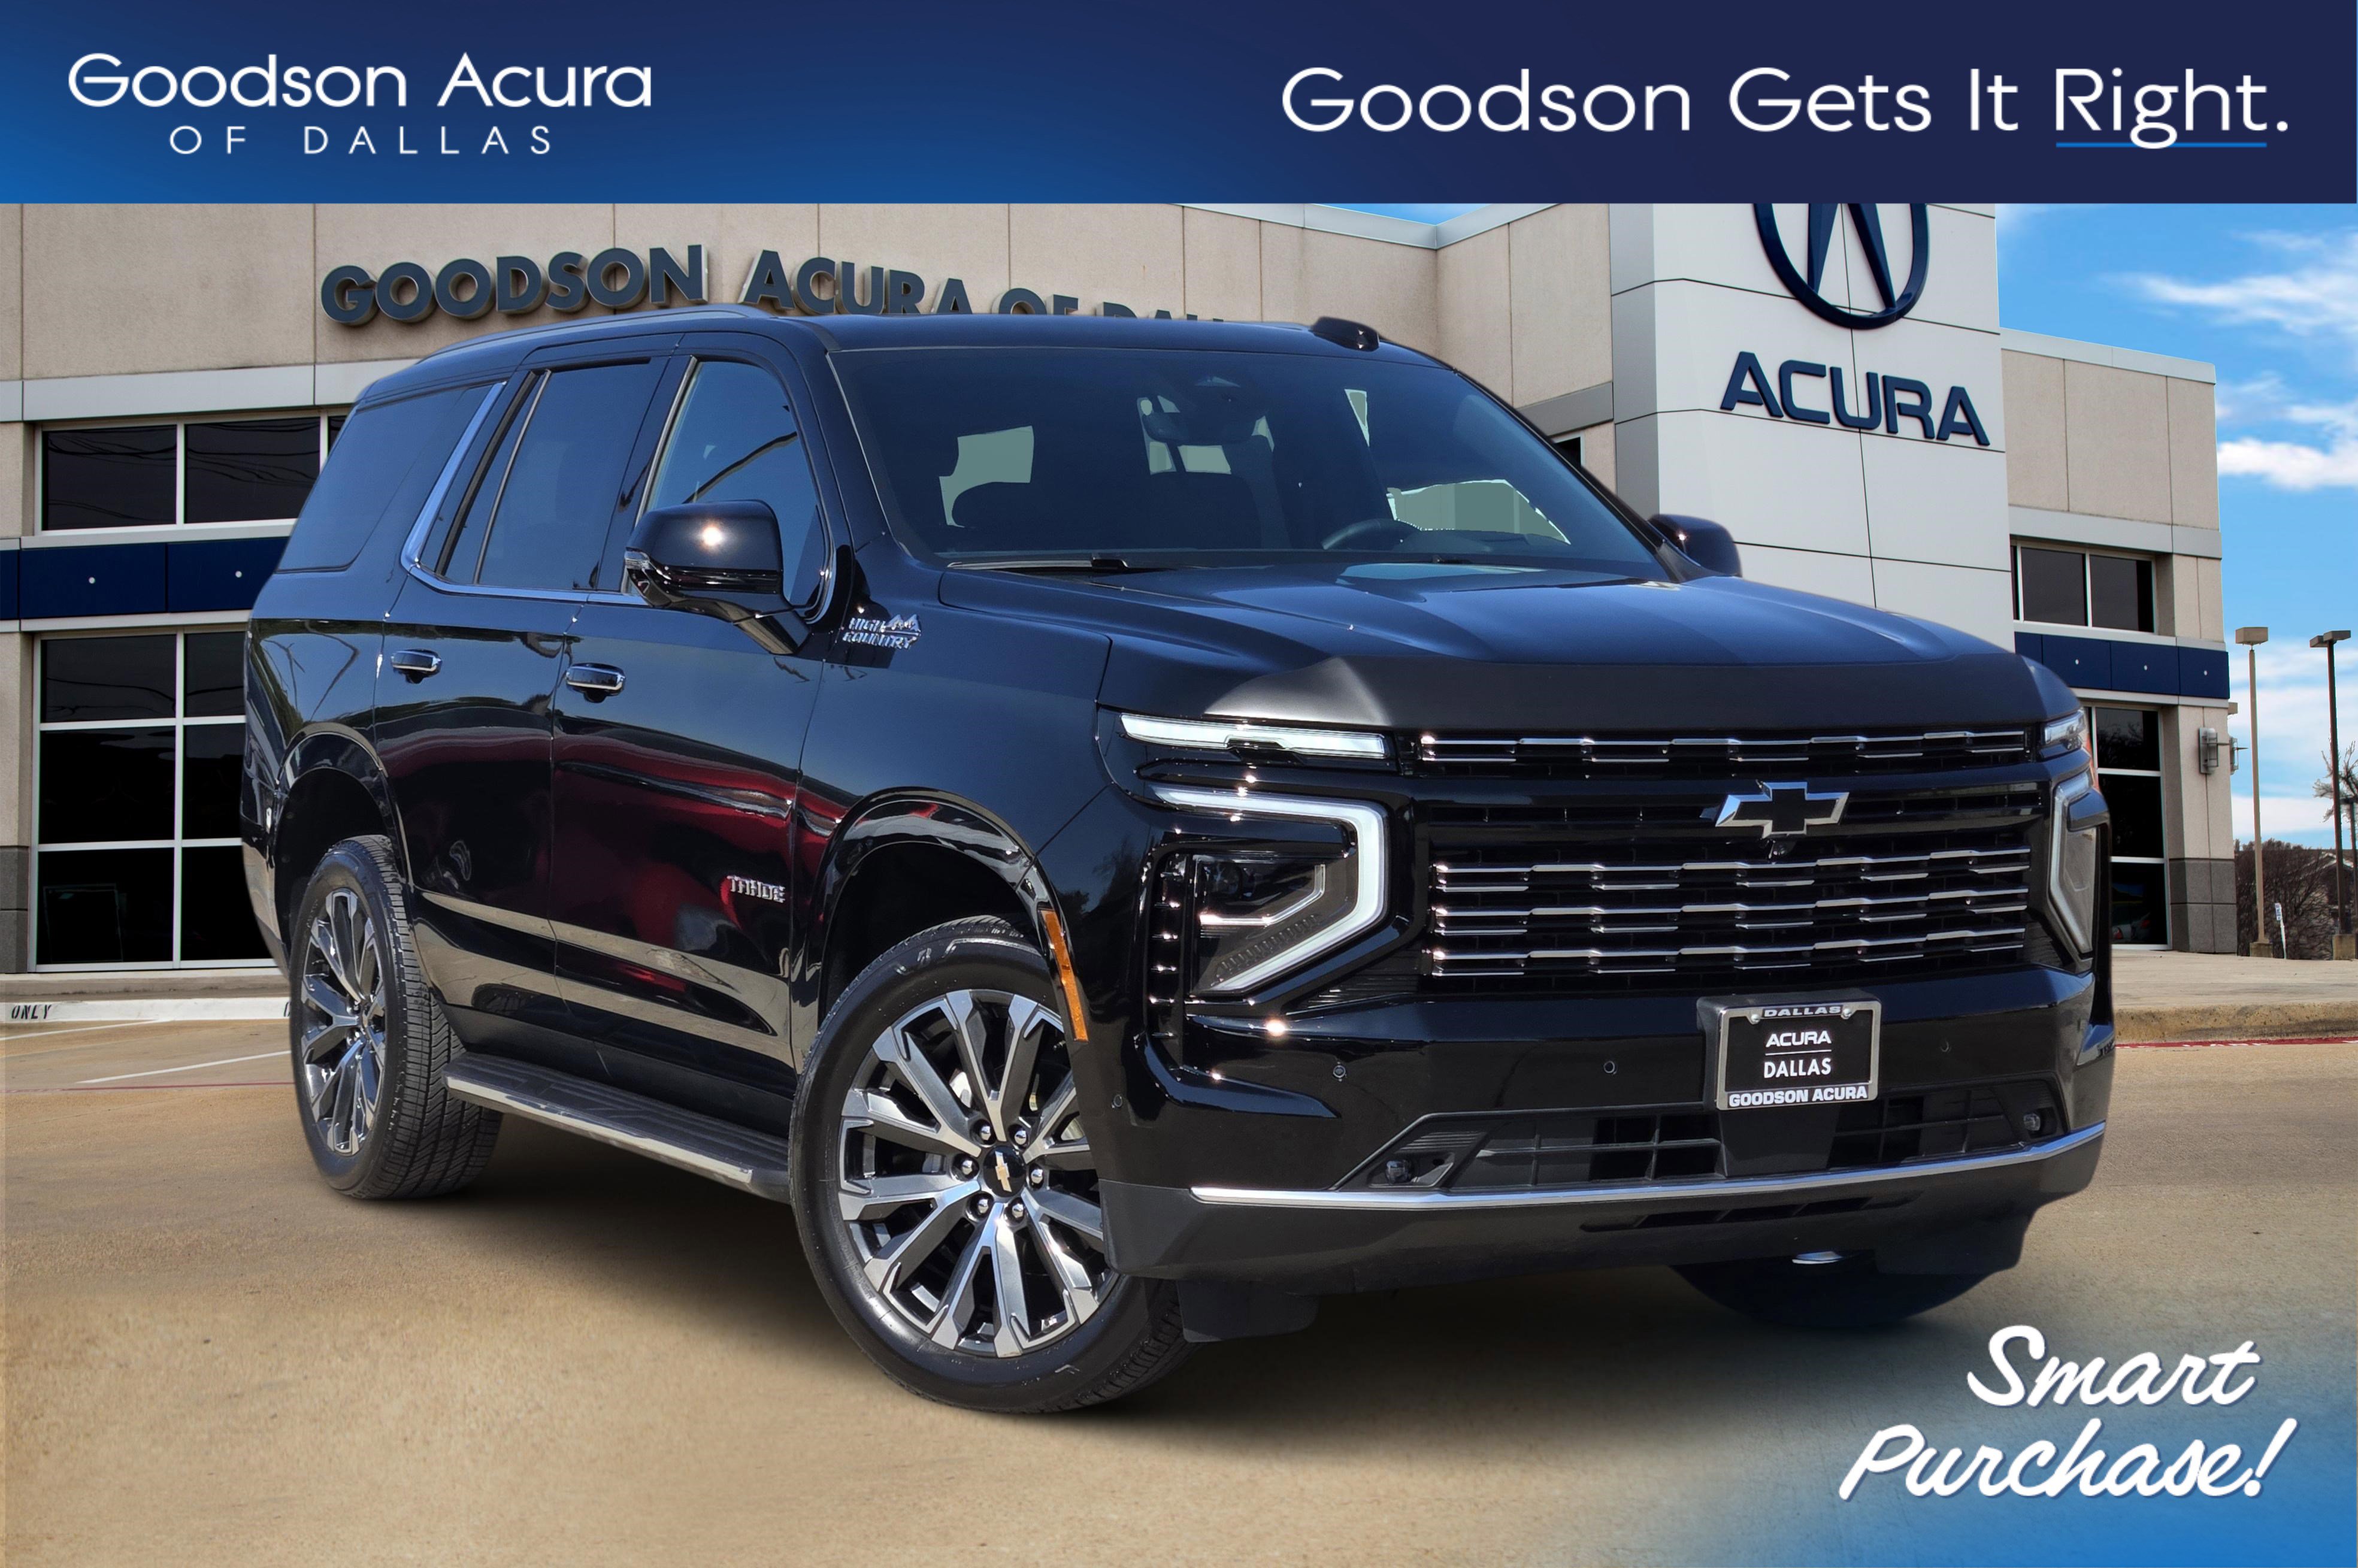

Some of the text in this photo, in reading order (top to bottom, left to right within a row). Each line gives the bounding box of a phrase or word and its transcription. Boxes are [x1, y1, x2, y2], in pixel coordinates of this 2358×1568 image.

[320, 244, 708, 326] GOODSON
[738, 249, 973, 315] ACURA
[1720, 351, 1990, 446] ACURA
[849, 617, 886, 632] HIGH
[842, 631, 917, 649] COUNTRY
[11, 1004, 52, 1019] ONLY
[1764, 1006, 1842, 1018] DALLAS
[1766, 1030, 1832, 1048] ACURA
[1764, 1057, 1832, 1079] DALLAS
[1729, 1085, 1868, 1107] GOODSON ACURA
